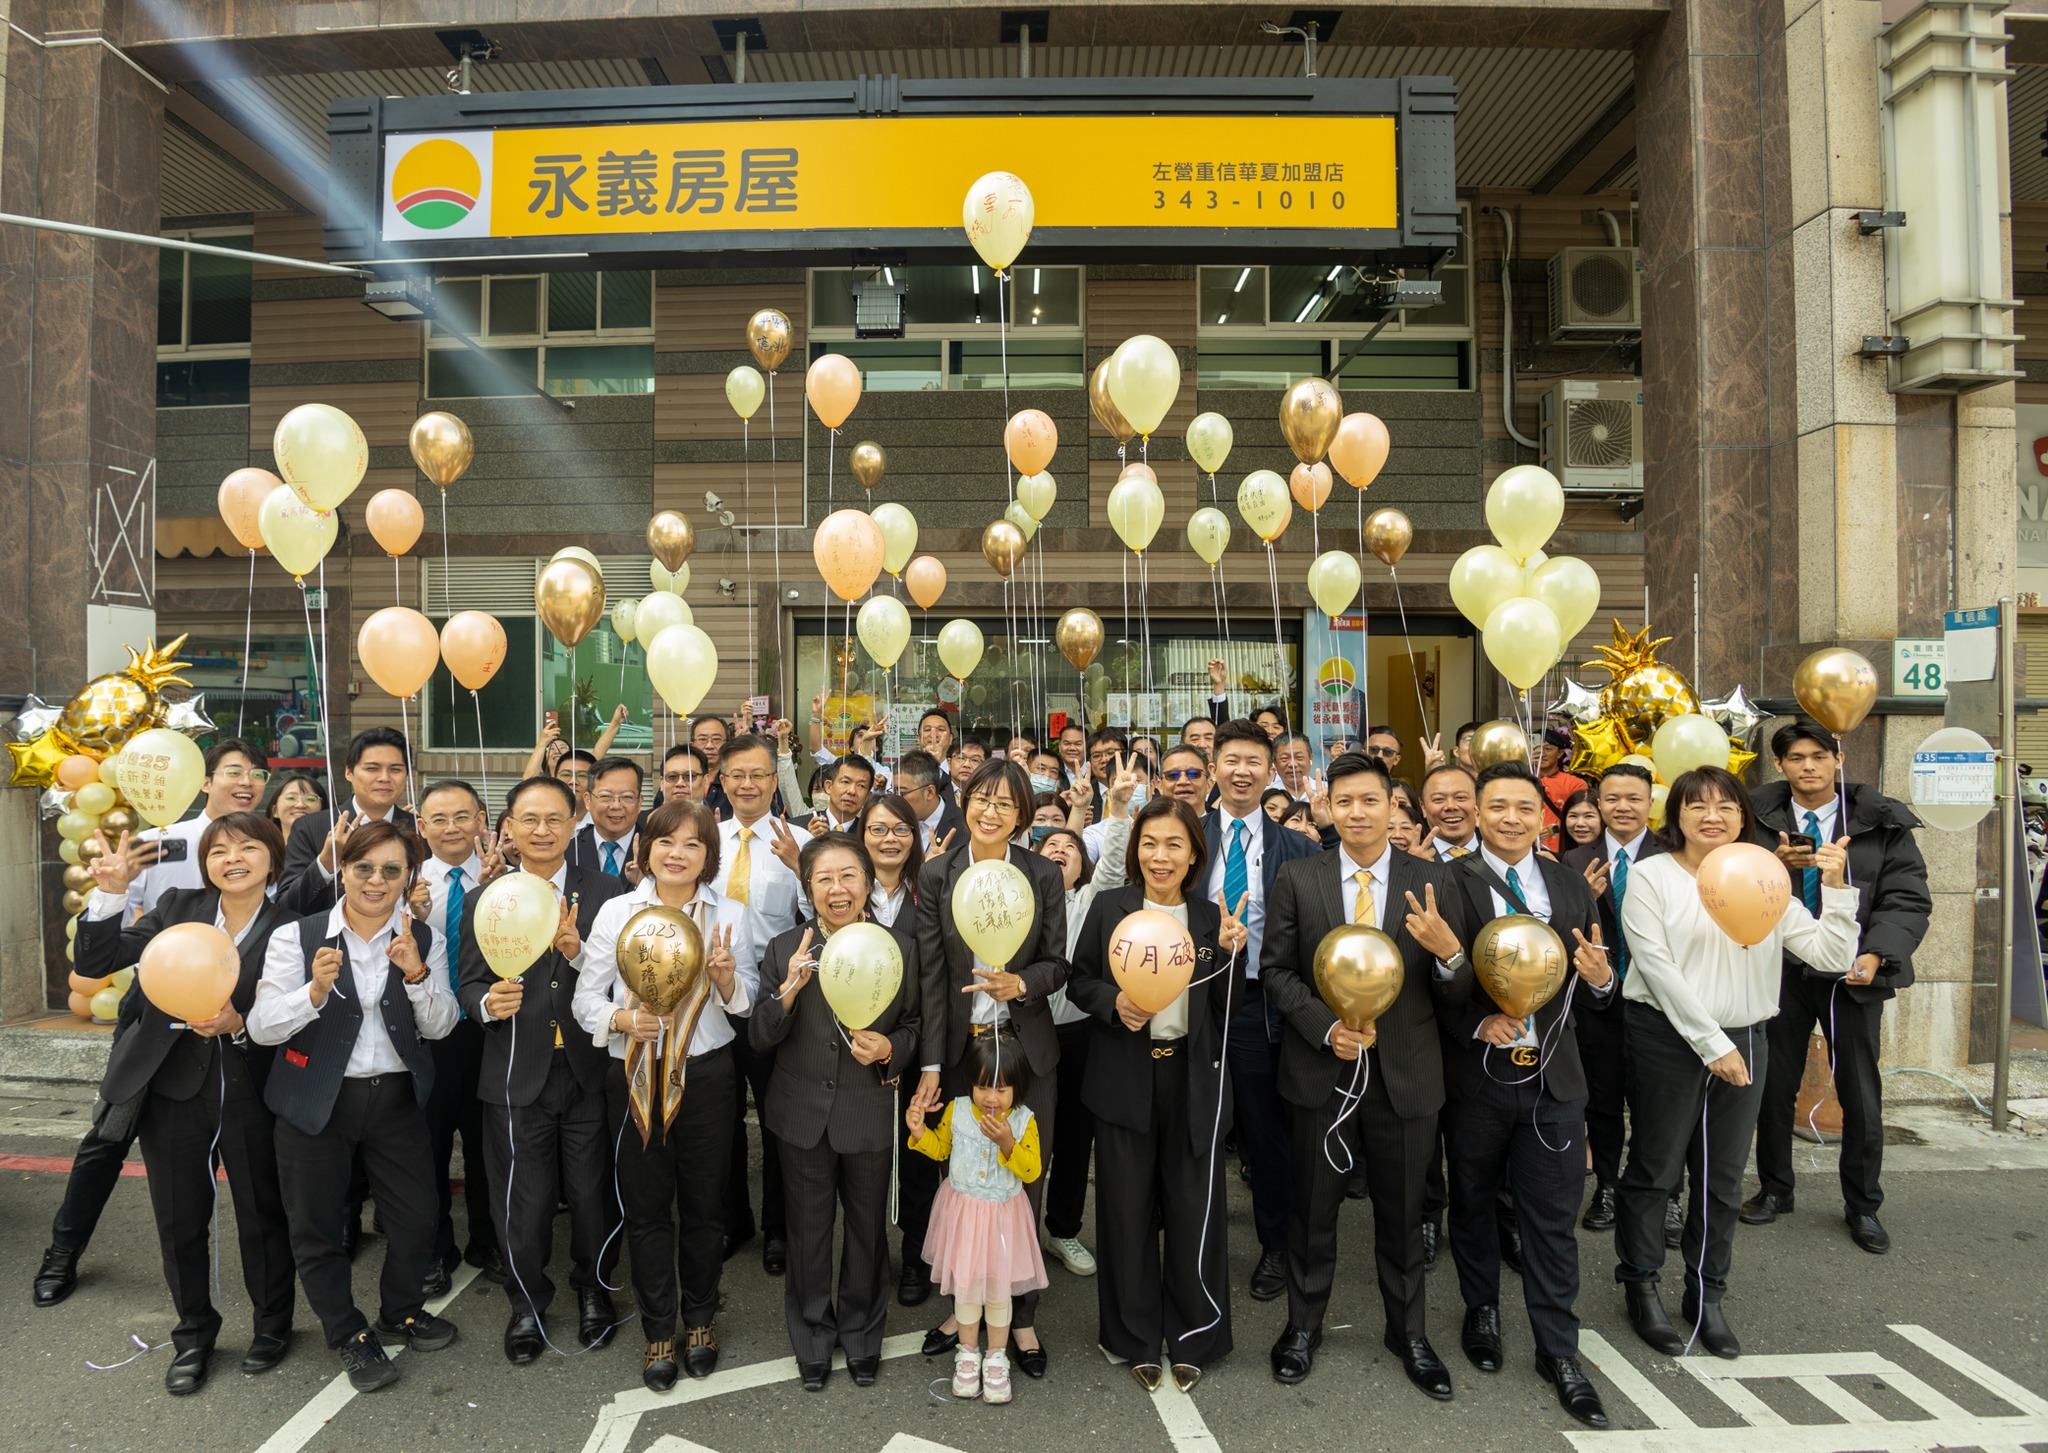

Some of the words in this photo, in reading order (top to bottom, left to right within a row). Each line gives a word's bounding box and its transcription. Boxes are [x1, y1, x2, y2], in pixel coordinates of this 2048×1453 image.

[1152, 161, 1345, 182] 左營重信華夏加盟店
[528, 148, 798, 219] 永義房屋
[632, 923, 678, 939] 2025
